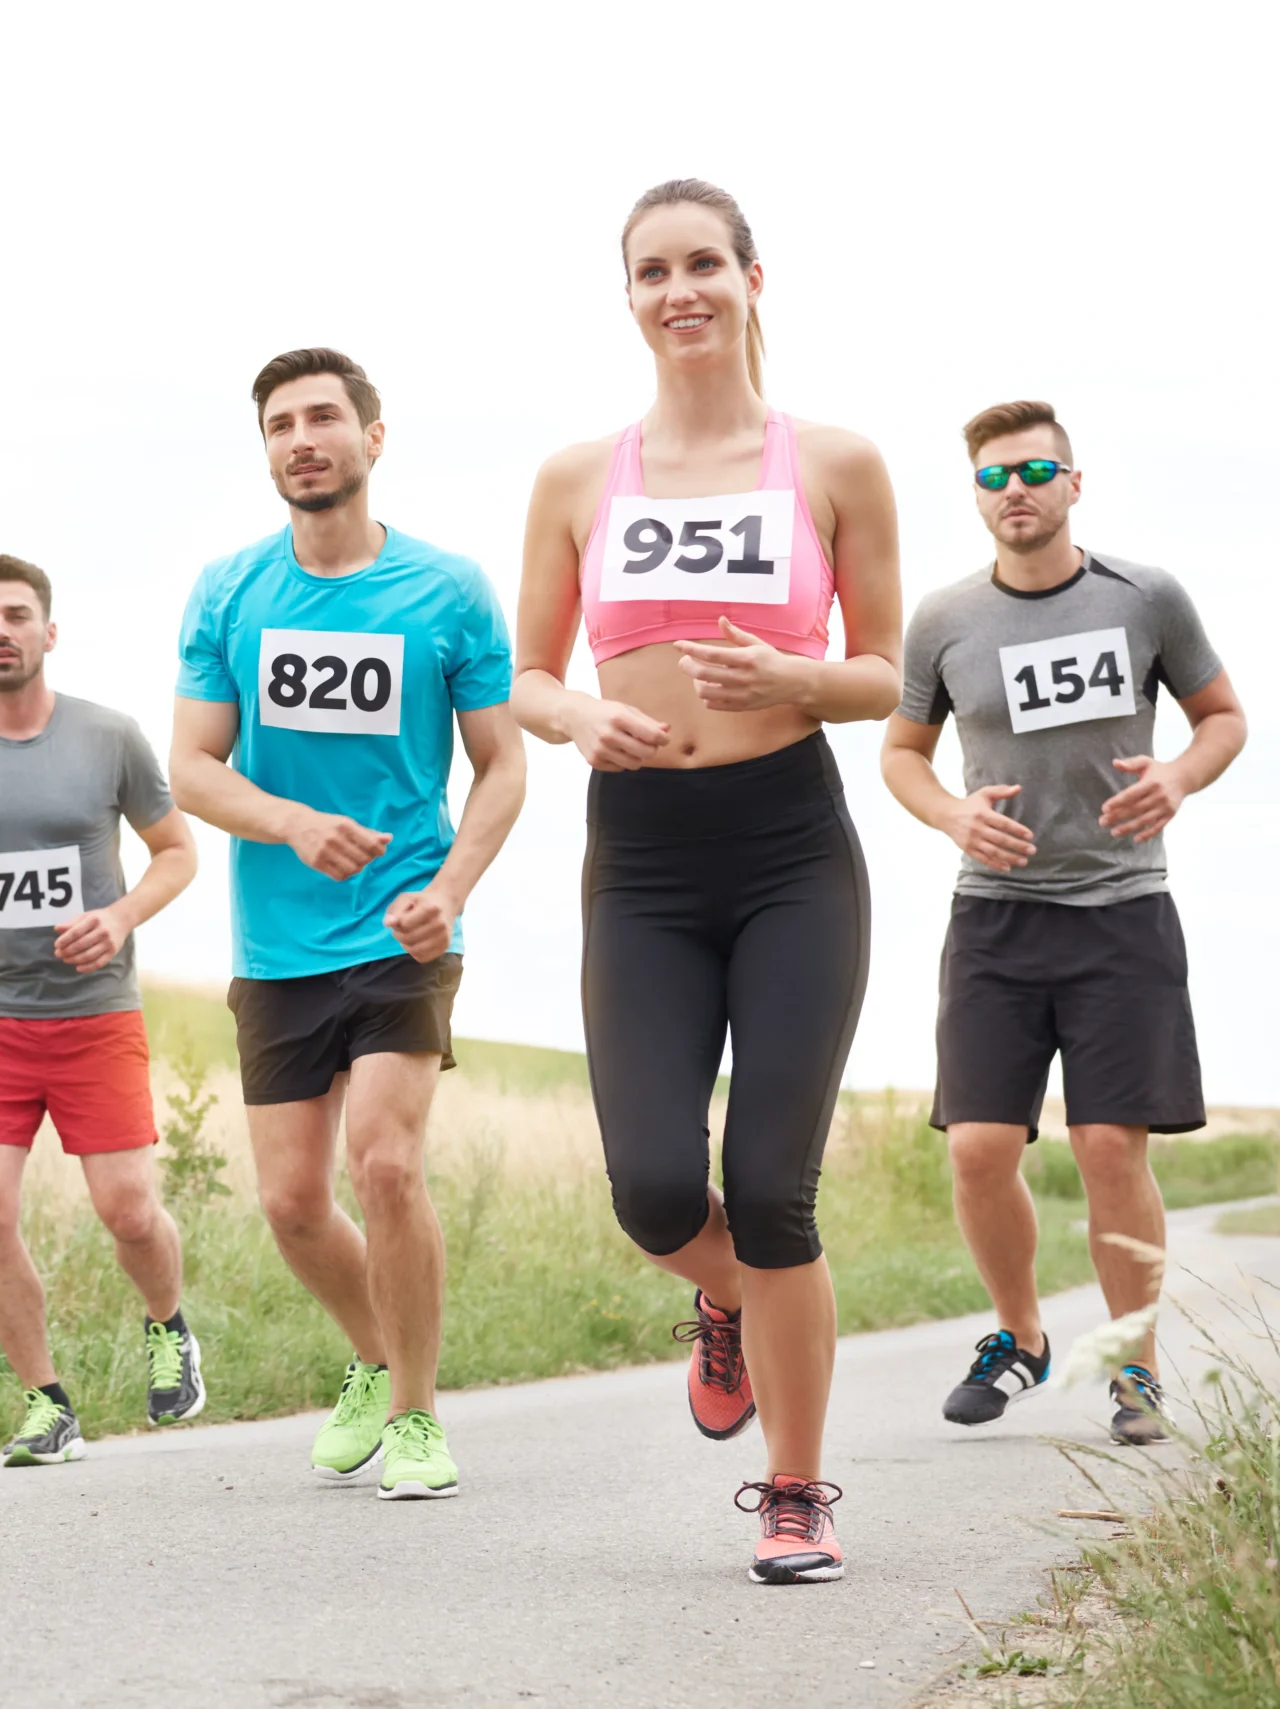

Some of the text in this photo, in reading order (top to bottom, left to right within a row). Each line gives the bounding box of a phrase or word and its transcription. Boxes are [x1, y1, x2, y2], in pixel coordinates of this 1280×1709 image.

[621, 514, 775, 575] 951
[267, 653, 392, 713] 820
[1013, 651, 1125, 712] 154
